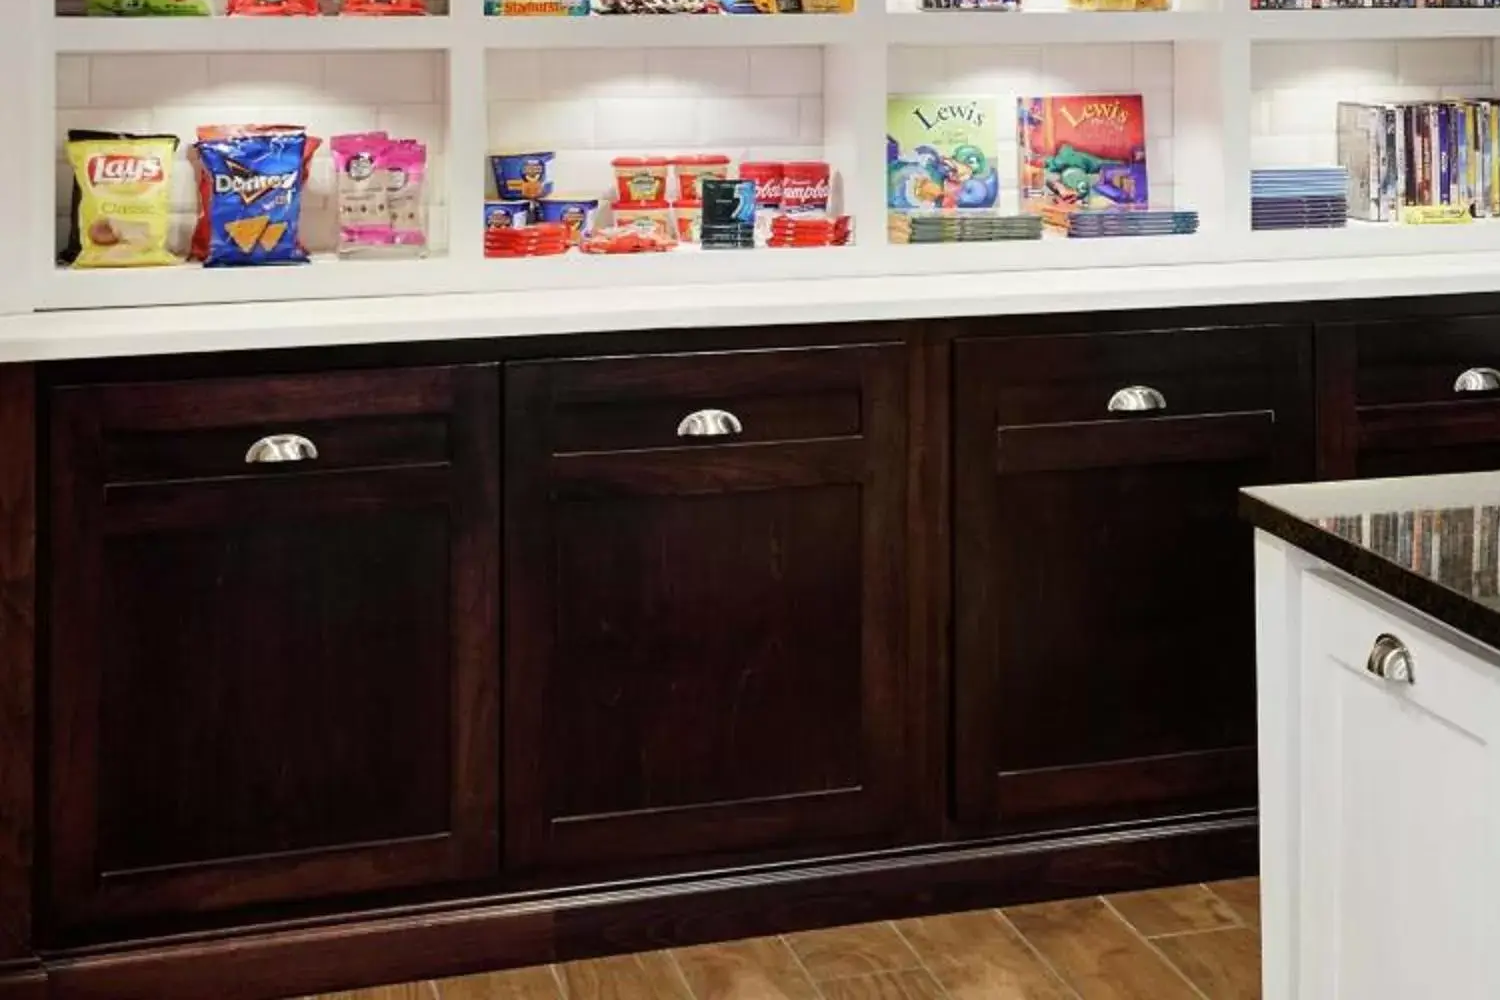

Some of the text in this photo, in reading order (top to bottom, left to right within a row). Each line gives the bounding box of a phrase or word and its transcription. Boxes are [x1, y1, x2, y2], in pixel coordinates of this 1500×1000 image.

[912, 101, 985, 131] Lewis
[1060, 101, 1130, 128] Lewis
[215, 170, 298, 193] Doritos
